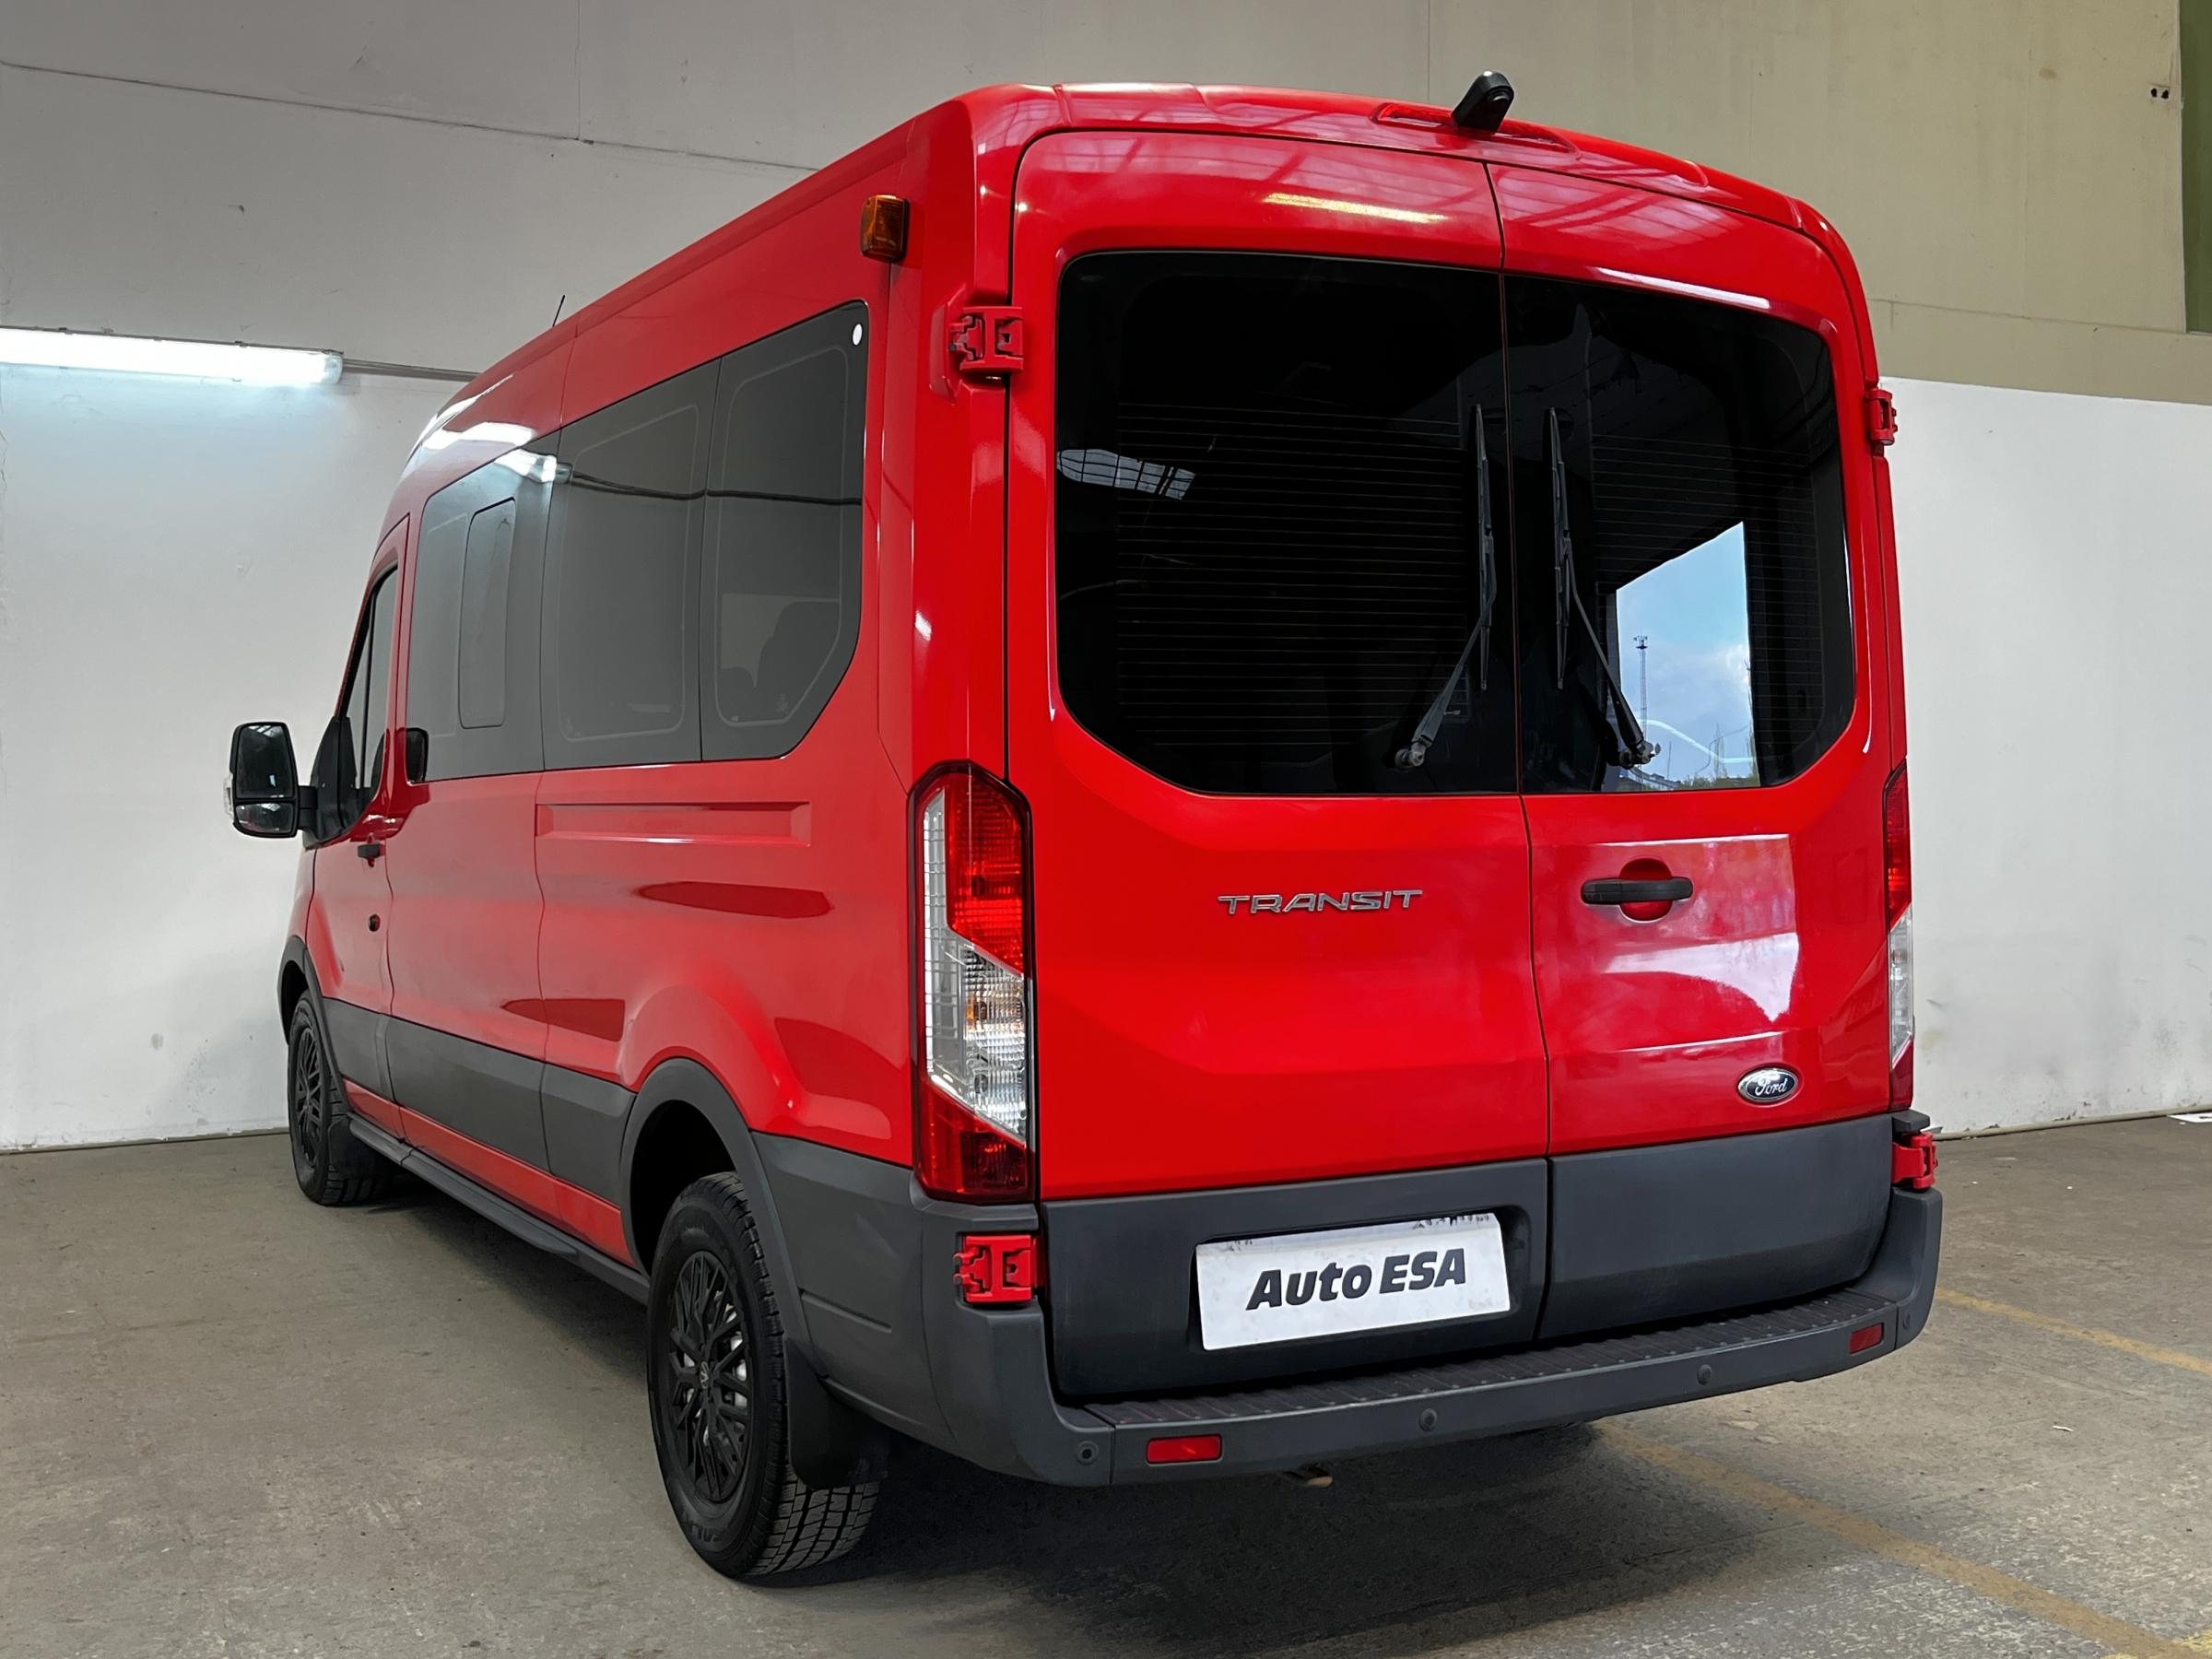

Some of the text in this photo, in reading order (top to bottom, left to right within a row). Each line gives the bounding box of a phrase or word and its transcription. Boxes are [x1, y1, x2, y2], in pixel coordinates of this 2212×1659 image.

[1218, 889, 1423, 915] TRANSIT
[1755, 1076, 1788, 1096] Ford
[1246, 1248, 1466, 1311] Auto ESA
